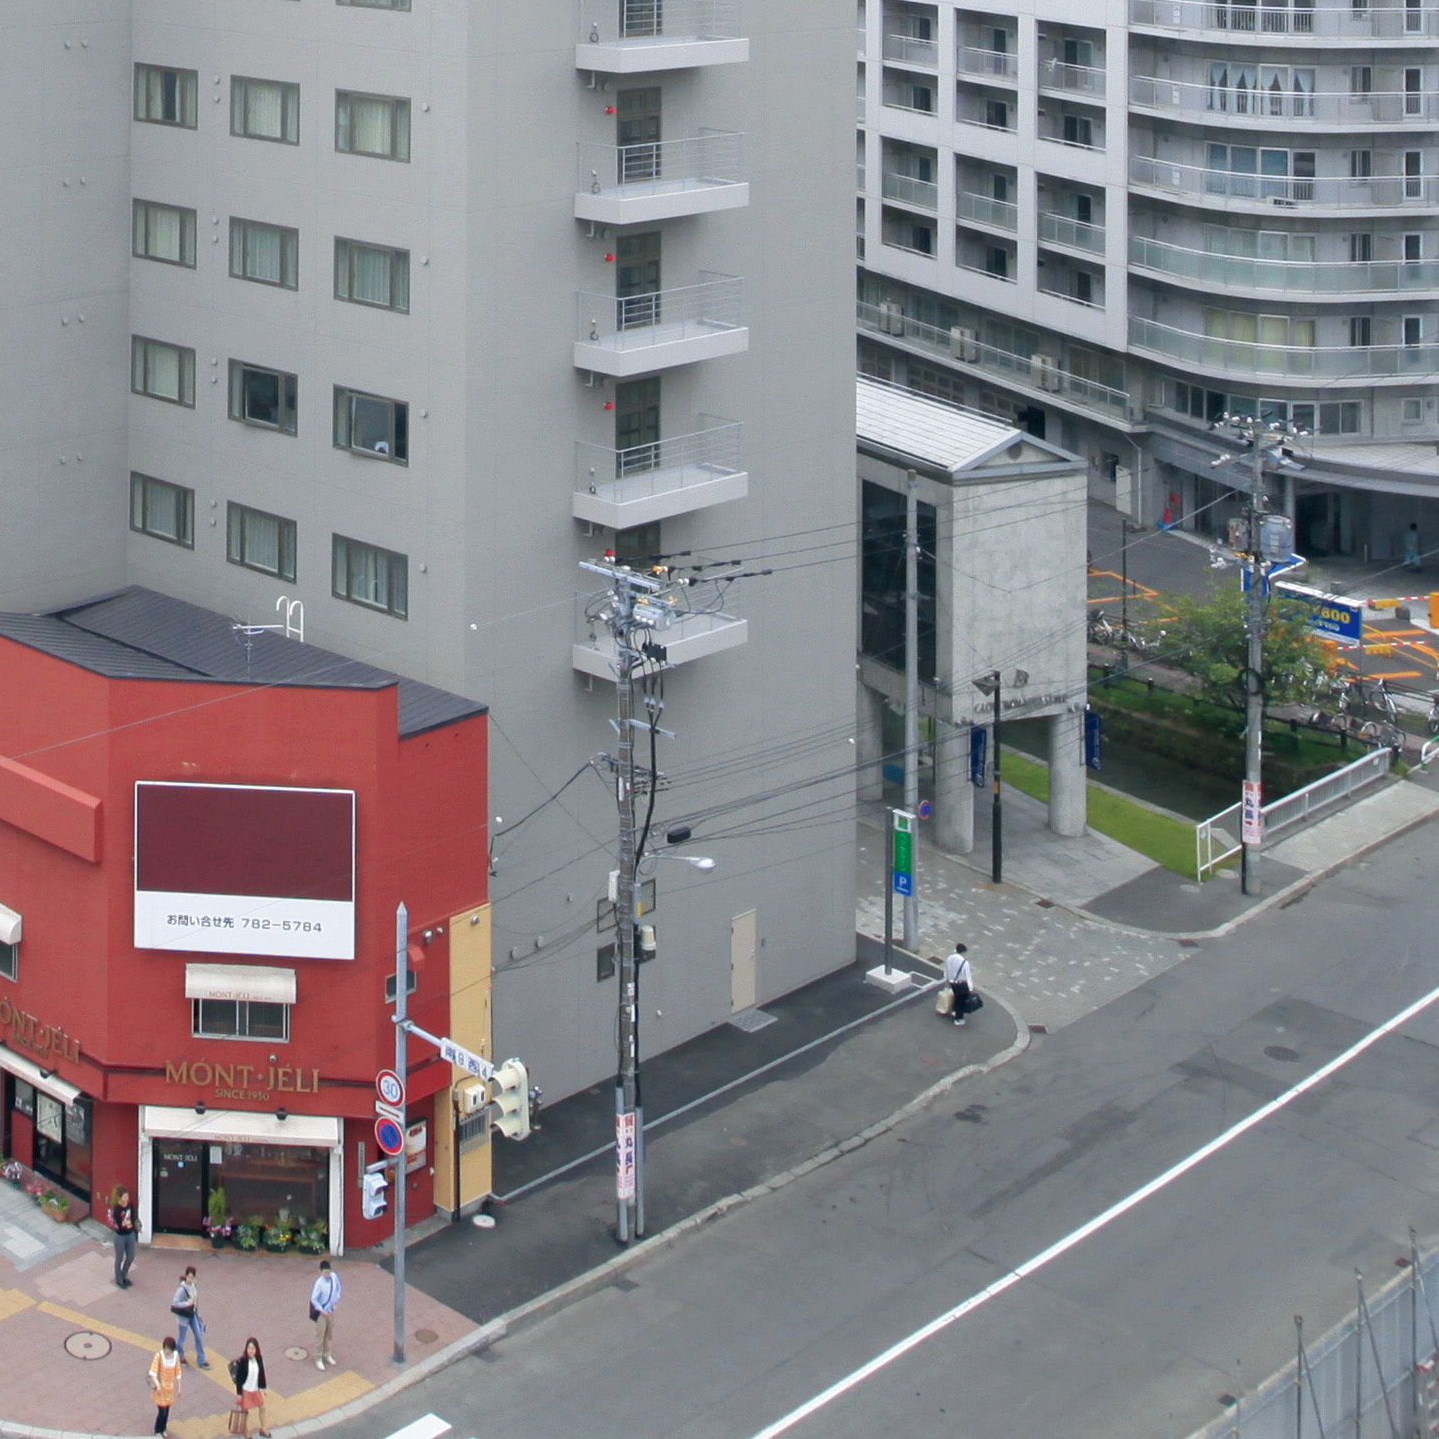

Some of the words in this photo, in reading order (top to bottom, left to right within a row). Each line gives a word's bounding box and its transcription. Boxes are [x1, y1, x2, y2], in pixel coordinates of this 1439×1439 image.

[167, 914, 235, 928] お問い合せ先
[241, 917, 323, 933] 782-5784
[215, 1088, 245, 1099] SINCE
[383, 1079, 398, 1099] 30
